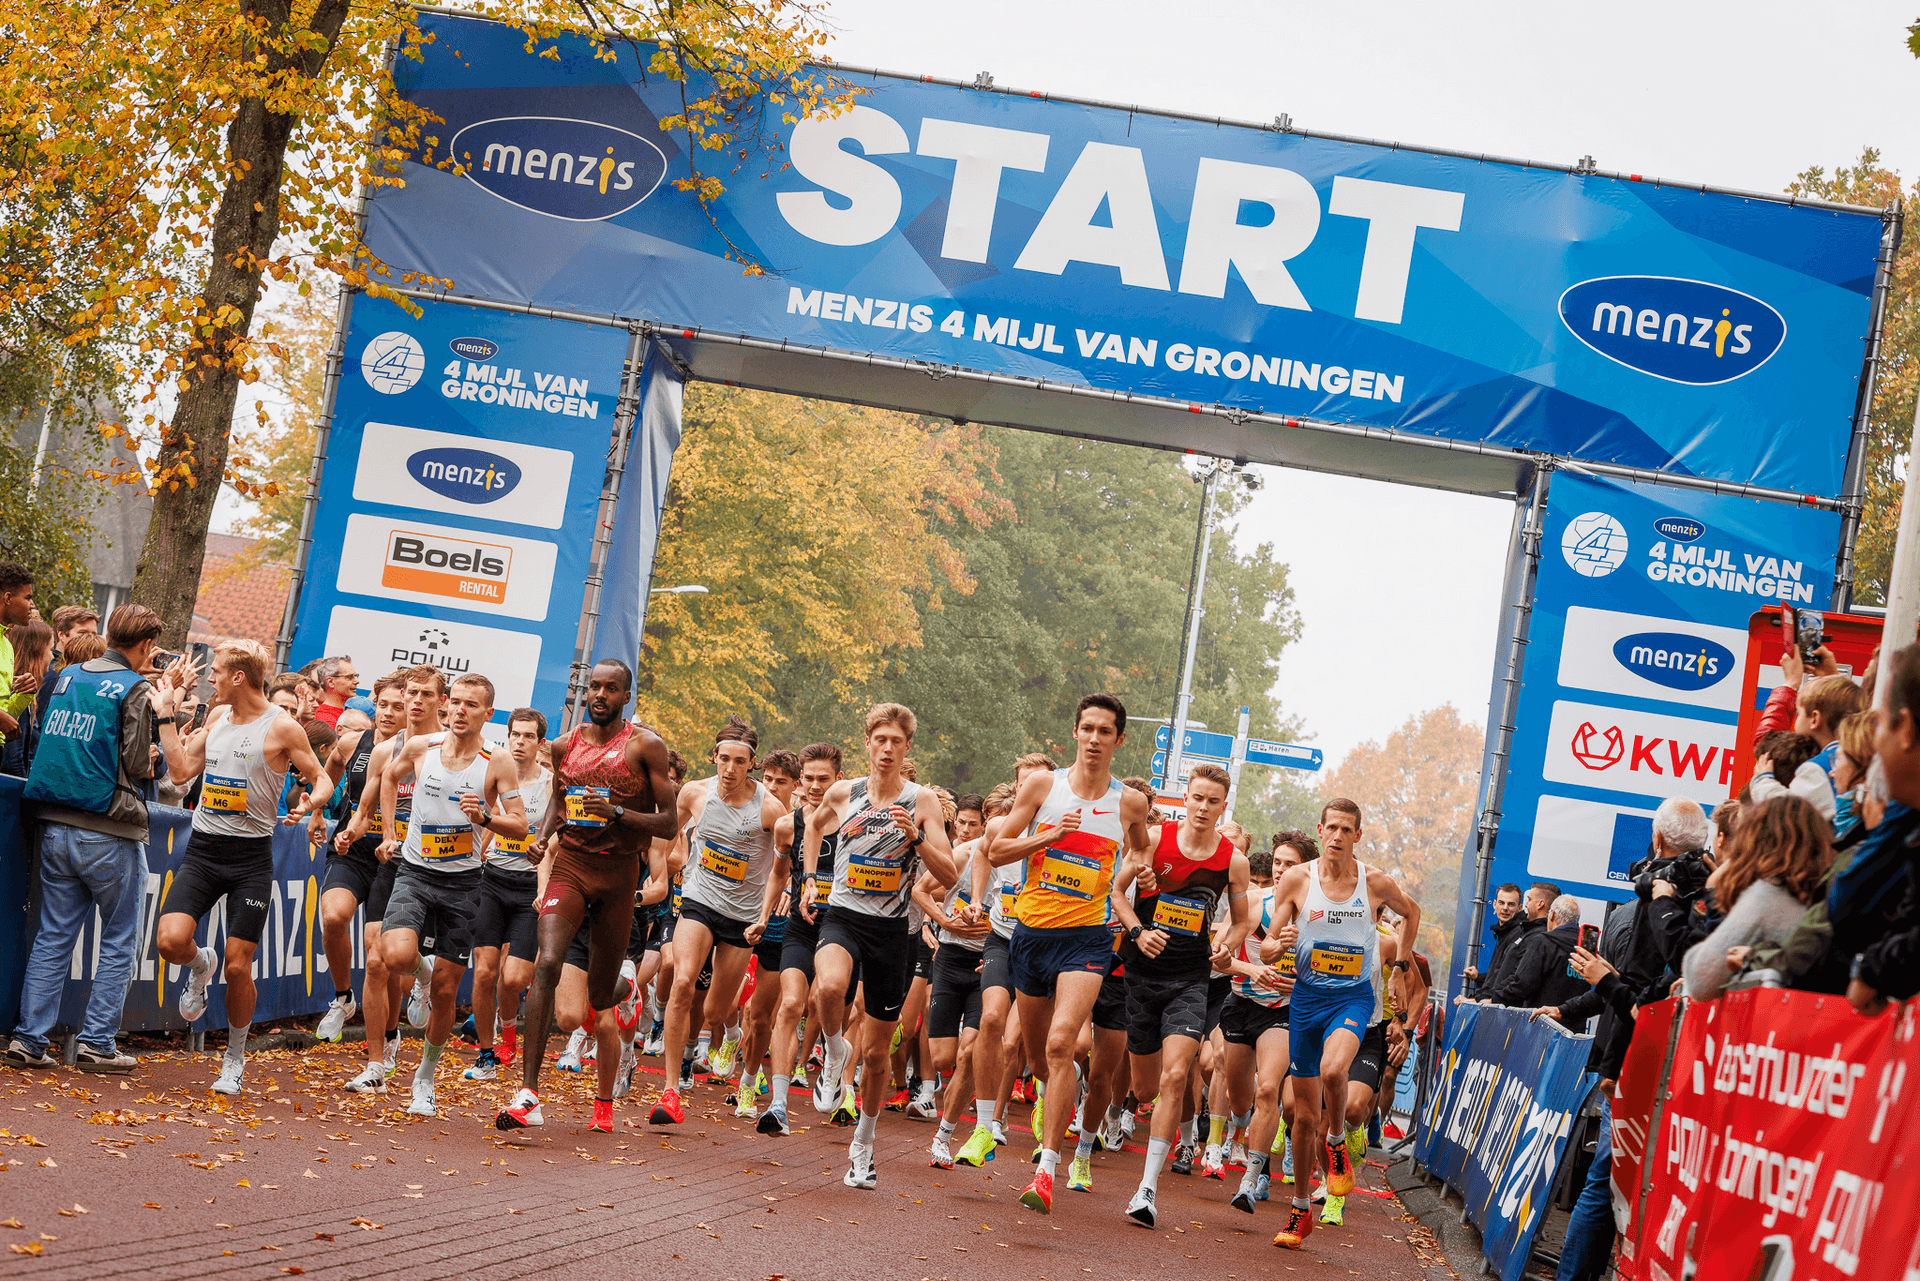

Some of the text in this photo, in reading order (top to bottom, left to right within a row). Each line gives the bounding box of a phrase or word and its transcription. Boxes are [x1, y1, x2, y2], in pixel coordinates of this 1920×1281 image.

[483, 142, 635, 195] menzis
[776, 104, 1465, 324] START
[1592, 302, 1752, 358] menzis
[457, 342, 492, 356] menzis
[786, 287, 1405, 403] MENZIS 4 MIJL VAN GRONINGEN
[444, 360, 588, 398] 4 MIJL VAN
[441, 379, 599, 419] GRONINGEN
[422, 460, 506, 491] menzis
[1660, 520, 1699, 538] menzis
[392, 536, 504, 576] Boels
[1648, 541, 1802, 581] 4 MIJL VAN
[1647, 561, 1814, 602] GRONINGEN
[459, 581, 499, 598] RENTAL
[391, 649, 470, 672] POUW
[1630, 645, 1718, 677] menzis
[96, 680, 124, 699] 22
[45, 709, 96, 742] GOLAZO
[1268, 745, 1290, 754] Haren
[206, 787, 240, 796] HENDRIKSE
[213, 798, 228, 807] M6
[436, 826, 456, 834] menzis
[434, 835, 459, 844] DELY
[507, 842, 521, 850] W8
[439, 845, 455, 855] M4
[709, 851, 740, 867] LEMMINK
[865, 859, 885, 867] menzis
[1063, 854, 1084, 865] menzis
[715, 864, 728, 873] M1
[854, 867, 895, 877] VANOPPEN
[865, 879, 882, 888] M2
[1056, 874, 1081, 887] M30
[1173, 899, 1192, 907] menzis
[1168, 916, 1188, 927] M21
[1327, 916, 1342, 925] lab
[1329, 945, 1348, 953] menzis
[1321, 953, 1354, 962] MICHIELS
[1328, 963, 1344, 972] M7
